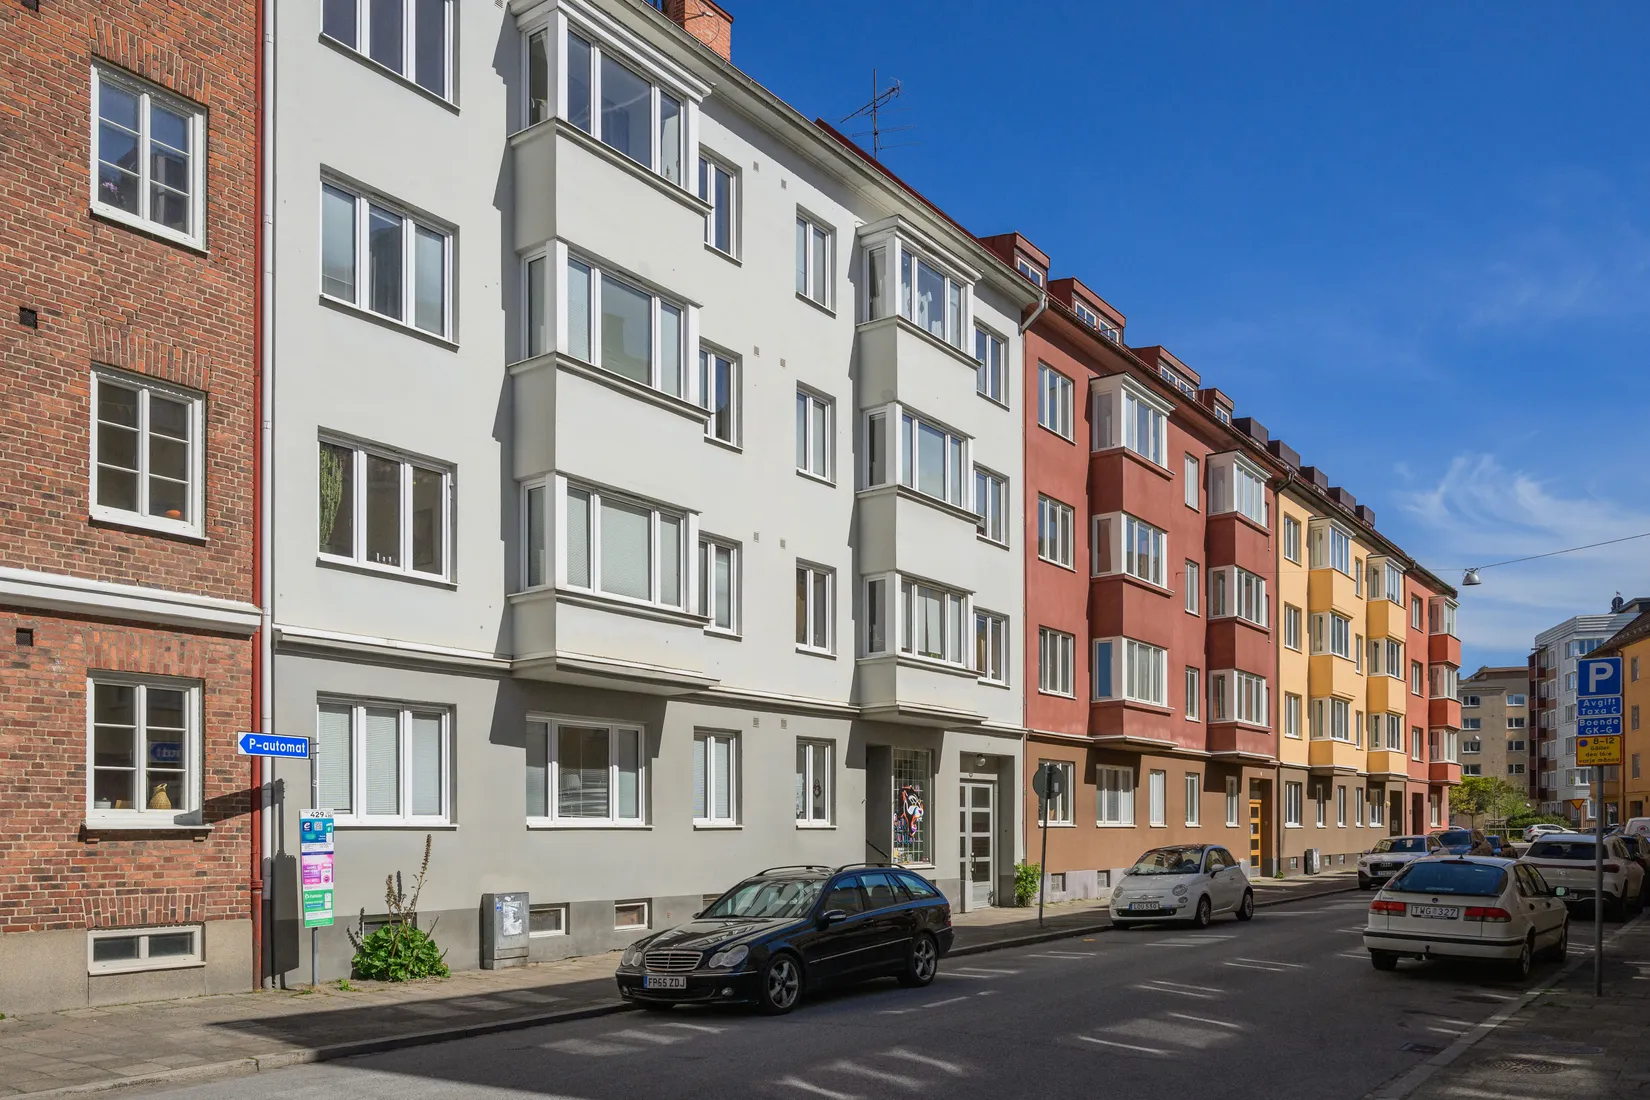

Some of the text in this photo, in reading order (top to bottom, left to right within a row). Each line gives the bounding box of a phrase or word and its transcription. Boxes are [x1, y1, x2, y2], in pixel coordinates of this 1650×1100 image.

[1588, 662, 1614, 692] P
[1583, 698, 1616, 707] Avgift
[1611, 706, 1617, 714] C
[1579, 718, 1619, 726] Boende
[249, 738, 306, 753] P-automat
[1414, 906, 1456, 917] TWG 327
[669, 977, 686, 988] ZDJ
